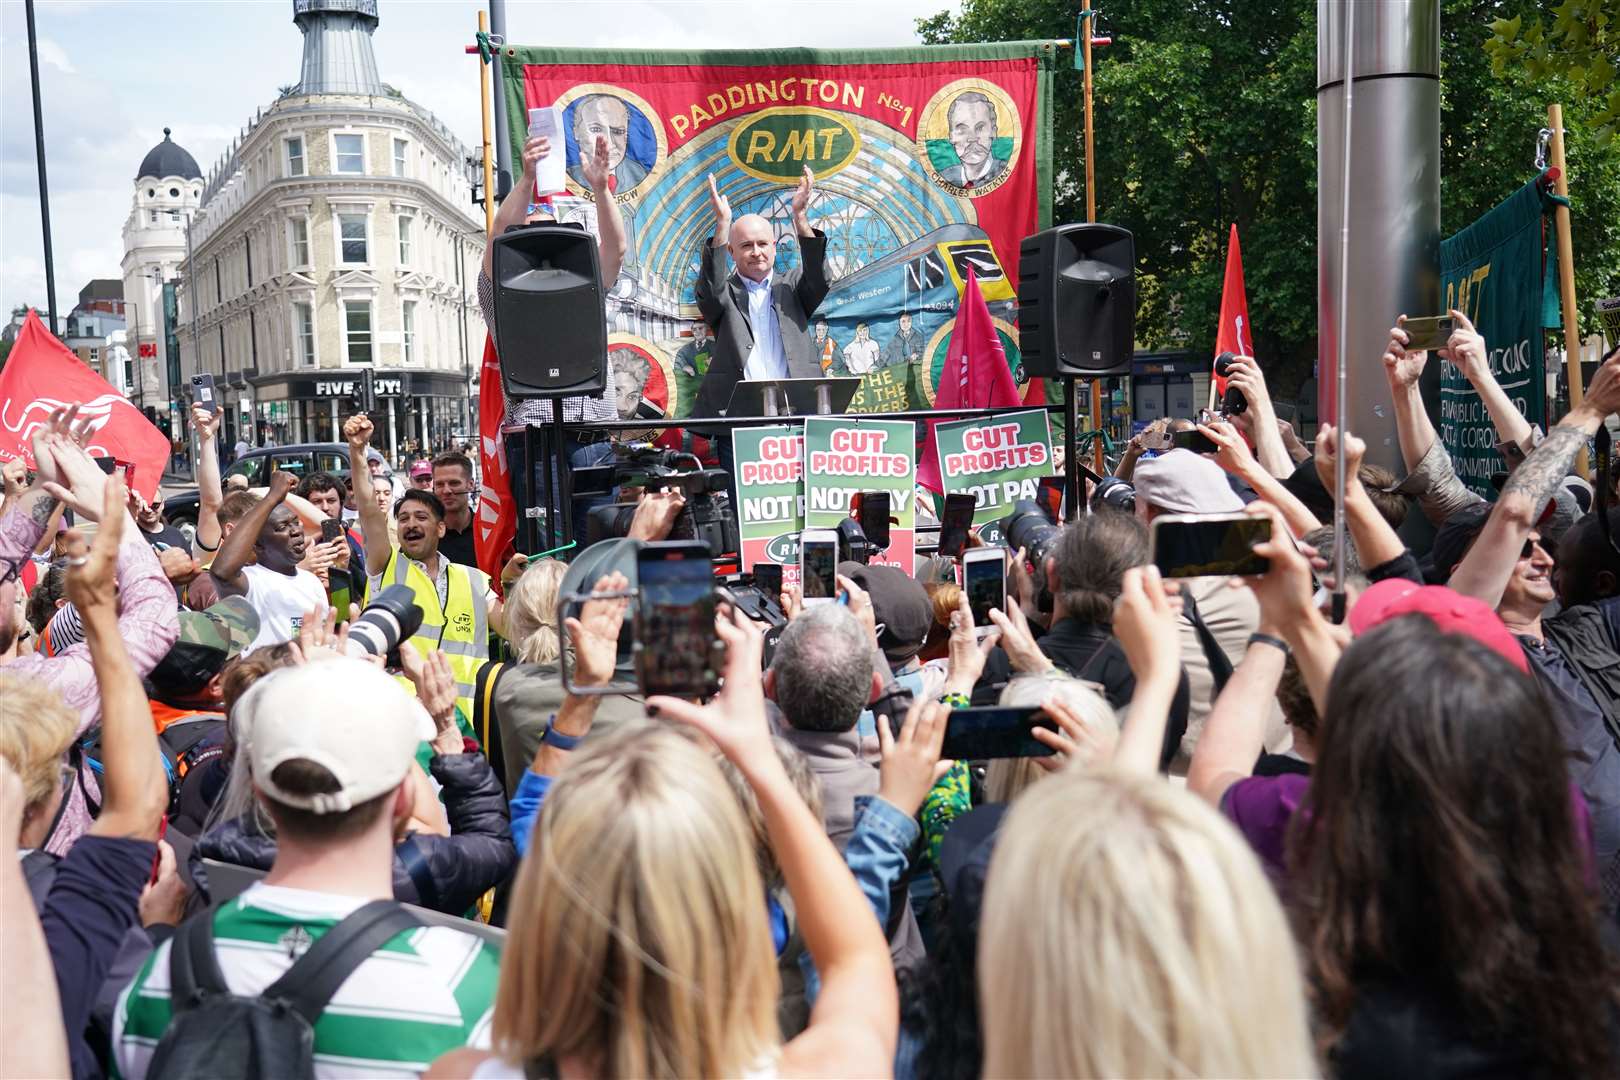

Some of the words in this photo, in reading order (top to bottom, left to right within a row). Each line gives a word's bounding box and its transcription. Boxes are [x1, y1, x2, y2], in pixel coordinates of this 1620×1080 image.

[671, 77, 864, 138] PADDINGTON
[746, 127, 842, 164] RMT
[931, 172, 969, 198] CHARLES
[975, 166, 1011, 196] WATKINS
[858, 286, 891, 300] Western
[316, 382, 354, 396] FIVE
[873, 382, 906, 402] THE
[832, 431, 885, 453] CUT
[965, 425, 1018, 451] CUT
[812, 454, 908, 475] PROFITS
[946, 444, 1045, 475] PROFITS
[743, 461, 804, 483] PROF
[743, 496, 792, 521] NOT
